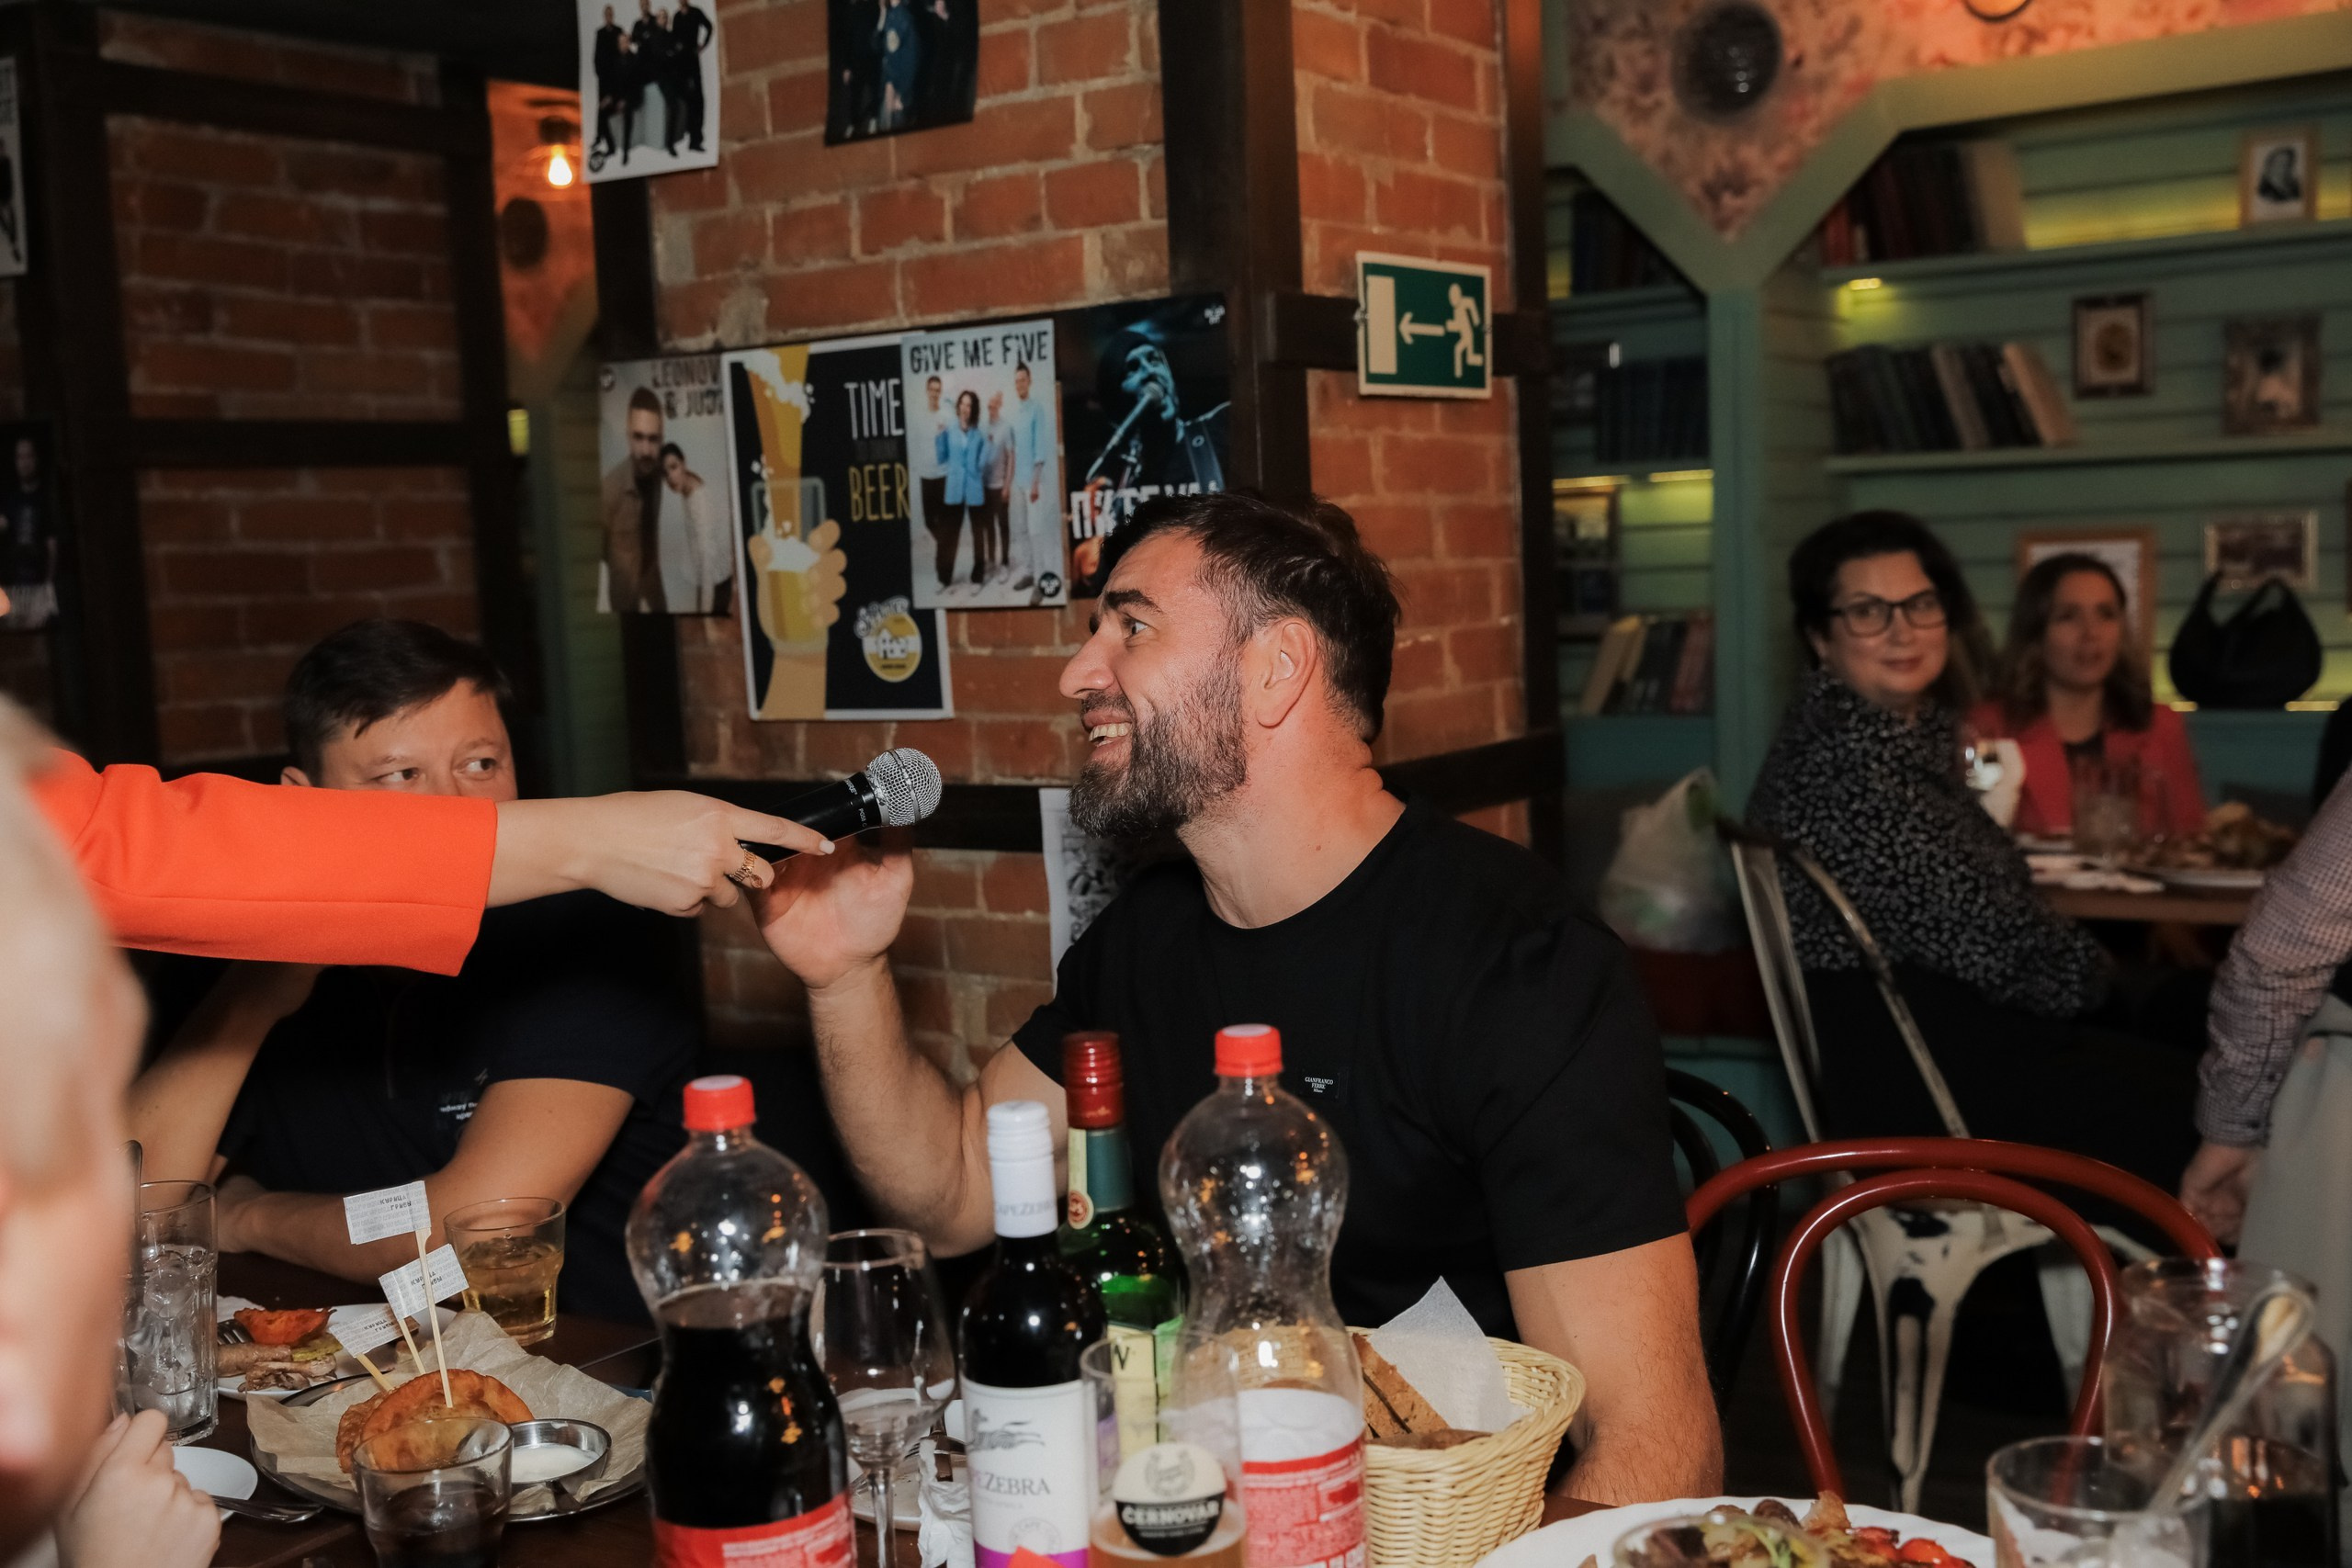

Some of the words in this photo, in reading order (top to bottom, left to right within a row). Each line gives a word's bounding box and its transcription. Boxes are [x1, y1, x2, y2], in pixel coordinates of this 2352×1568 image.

[963, 337, 993, 368] ME
[843, 378, 904, 440] TIME
[848, 462, 910, 523] BEER
